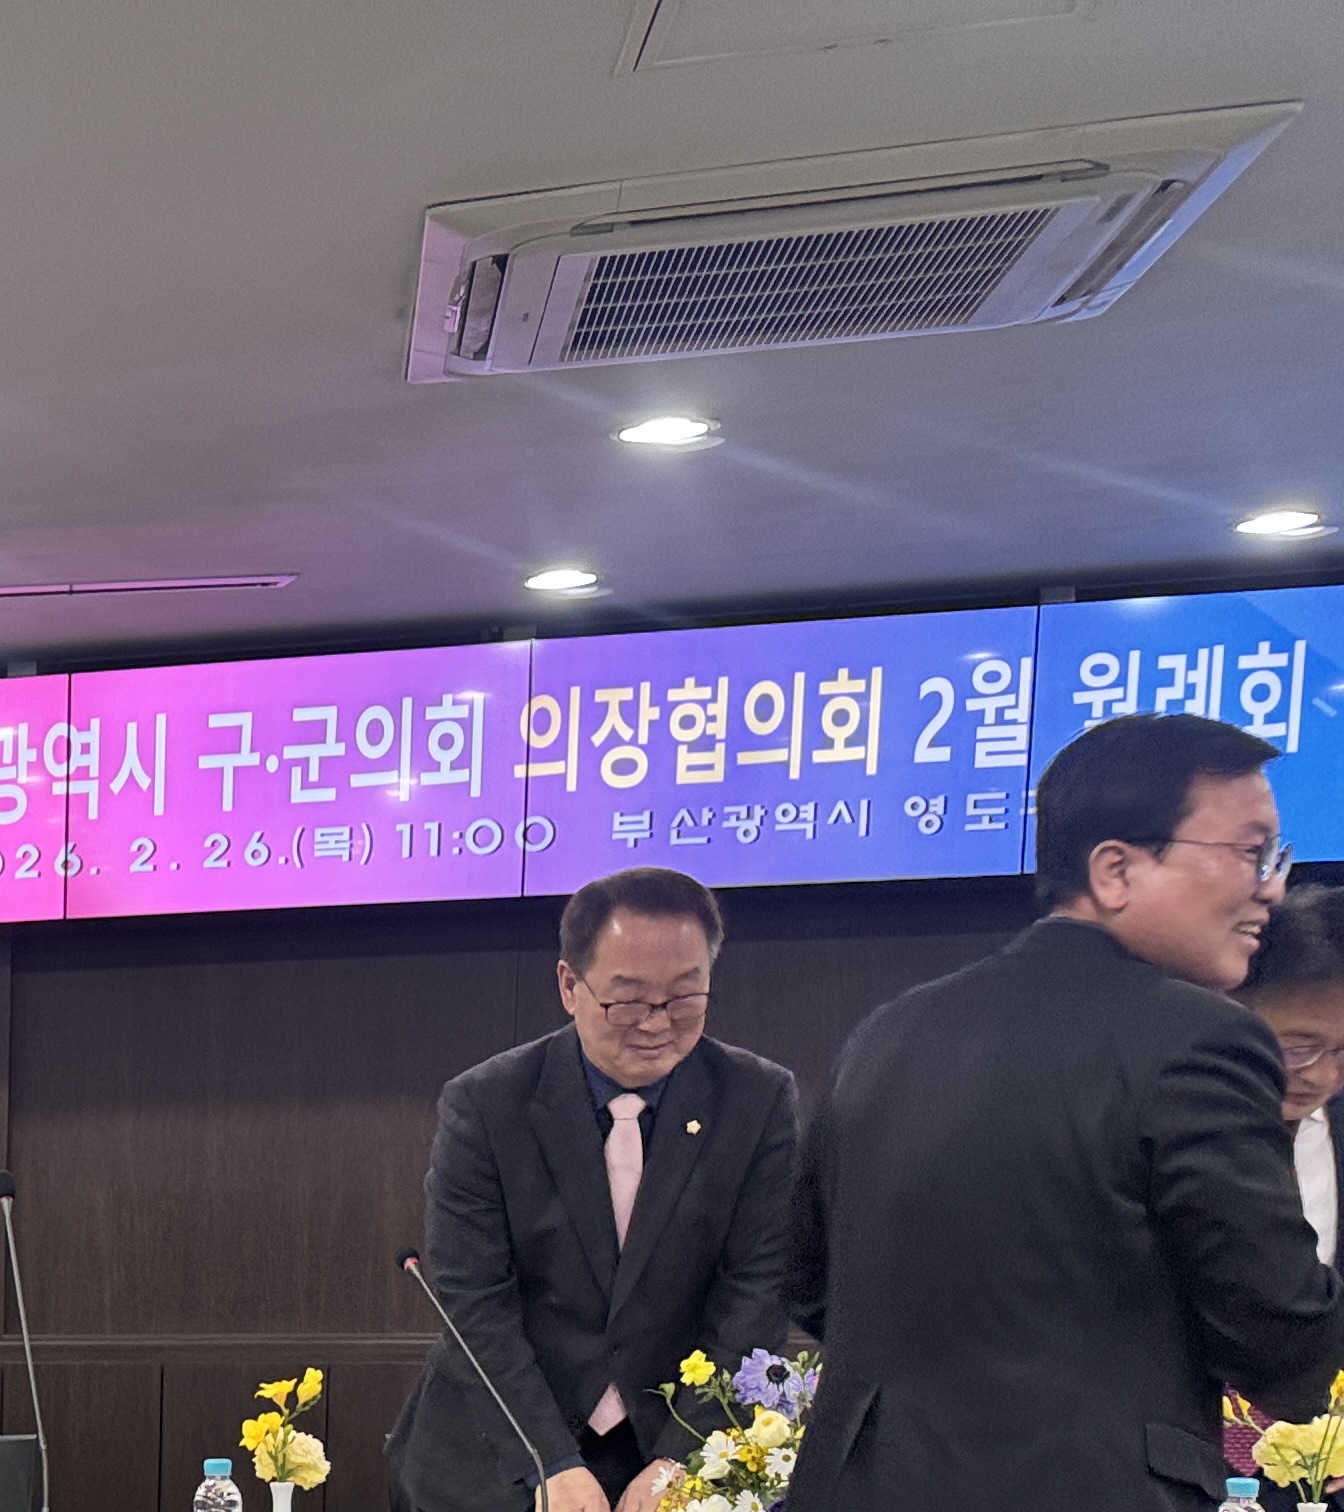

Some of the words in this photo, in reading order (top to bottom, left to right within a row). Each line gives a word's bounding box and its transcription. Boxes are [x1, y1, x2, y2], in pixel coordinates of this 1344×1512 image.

[199, 693, 486, 812] 구·군의회
[513, 665, 884, 792] 의장협의회
[914, 657, 1034, 769] 2월
[130, 836, 180, 875] 2.
[396, 815, 557, 860] 11:00
[611, 797, 871, 849] 부산광역시
[903, 790, 1037, 834] 영도
